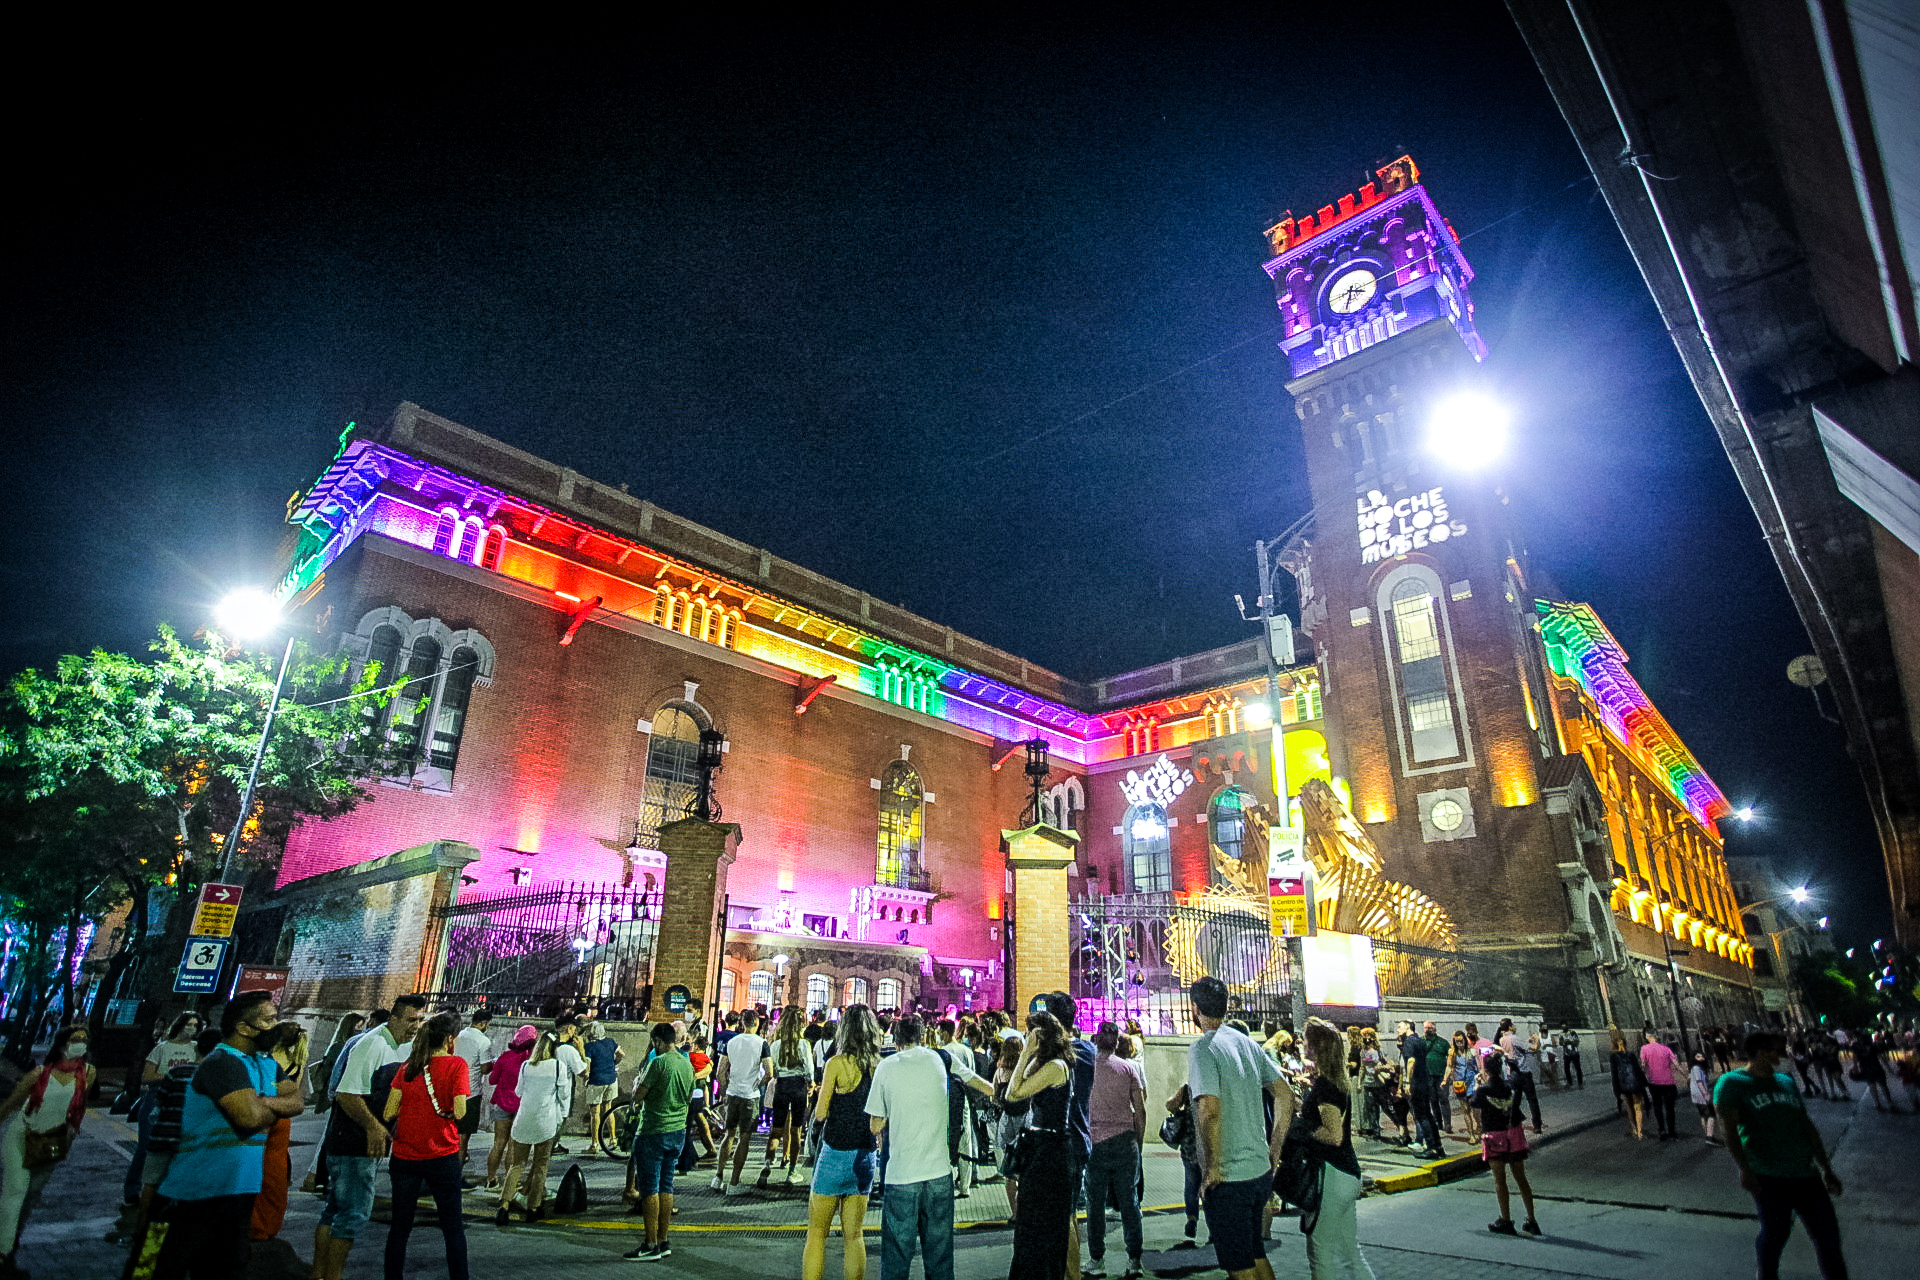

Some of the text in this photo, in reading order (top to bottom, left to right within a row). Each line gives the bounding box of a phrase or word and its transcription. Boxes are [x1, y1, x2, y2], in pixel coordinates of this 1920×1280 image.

[1357, 489, 1387, 514] LA
[1357, 487, 1443, 531] NOCHE
[1359, 503, 1449, 548] DE LOS
[1361, 520, 1468, 565] MUSEOS
